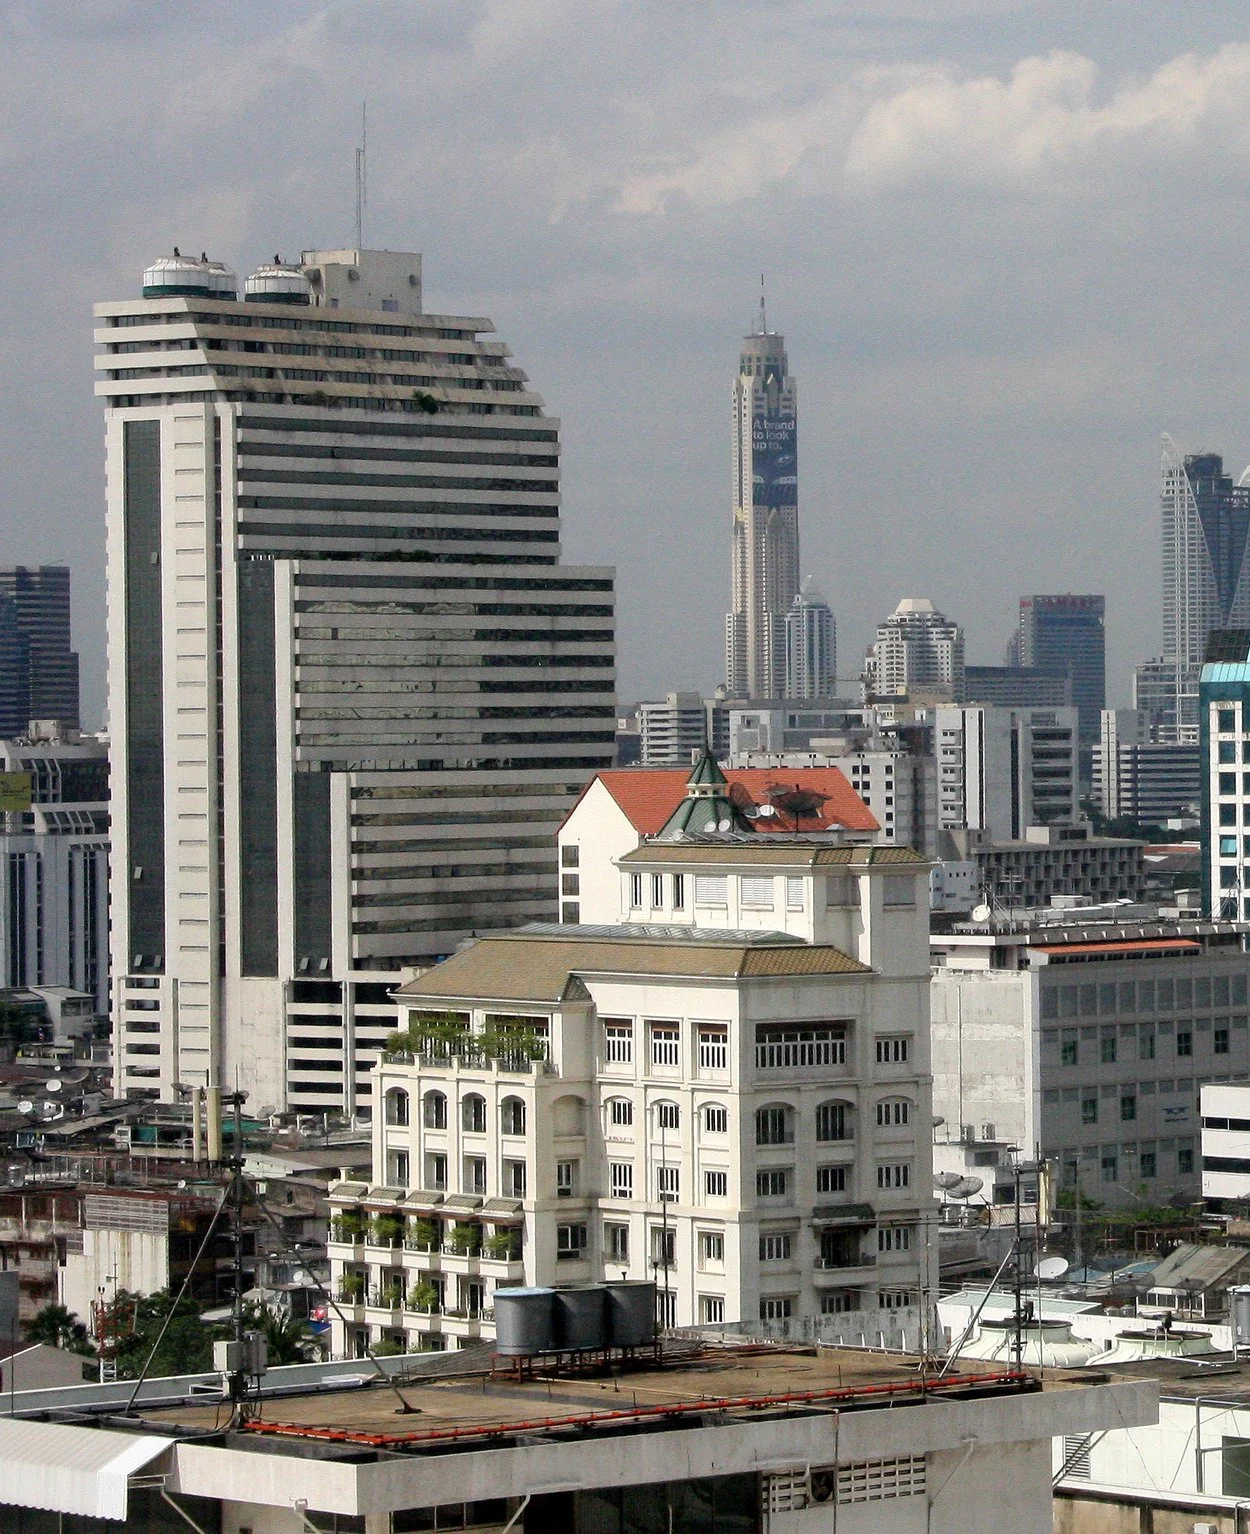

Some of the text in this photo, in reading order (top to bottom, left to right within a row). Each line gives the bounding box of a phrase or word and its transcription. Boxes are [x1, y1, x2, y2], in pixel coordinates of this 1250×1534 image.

[764, 419, 795, 430] brand
[753, 430, 789, 440] to look
[753, 442, 767, 451] up
